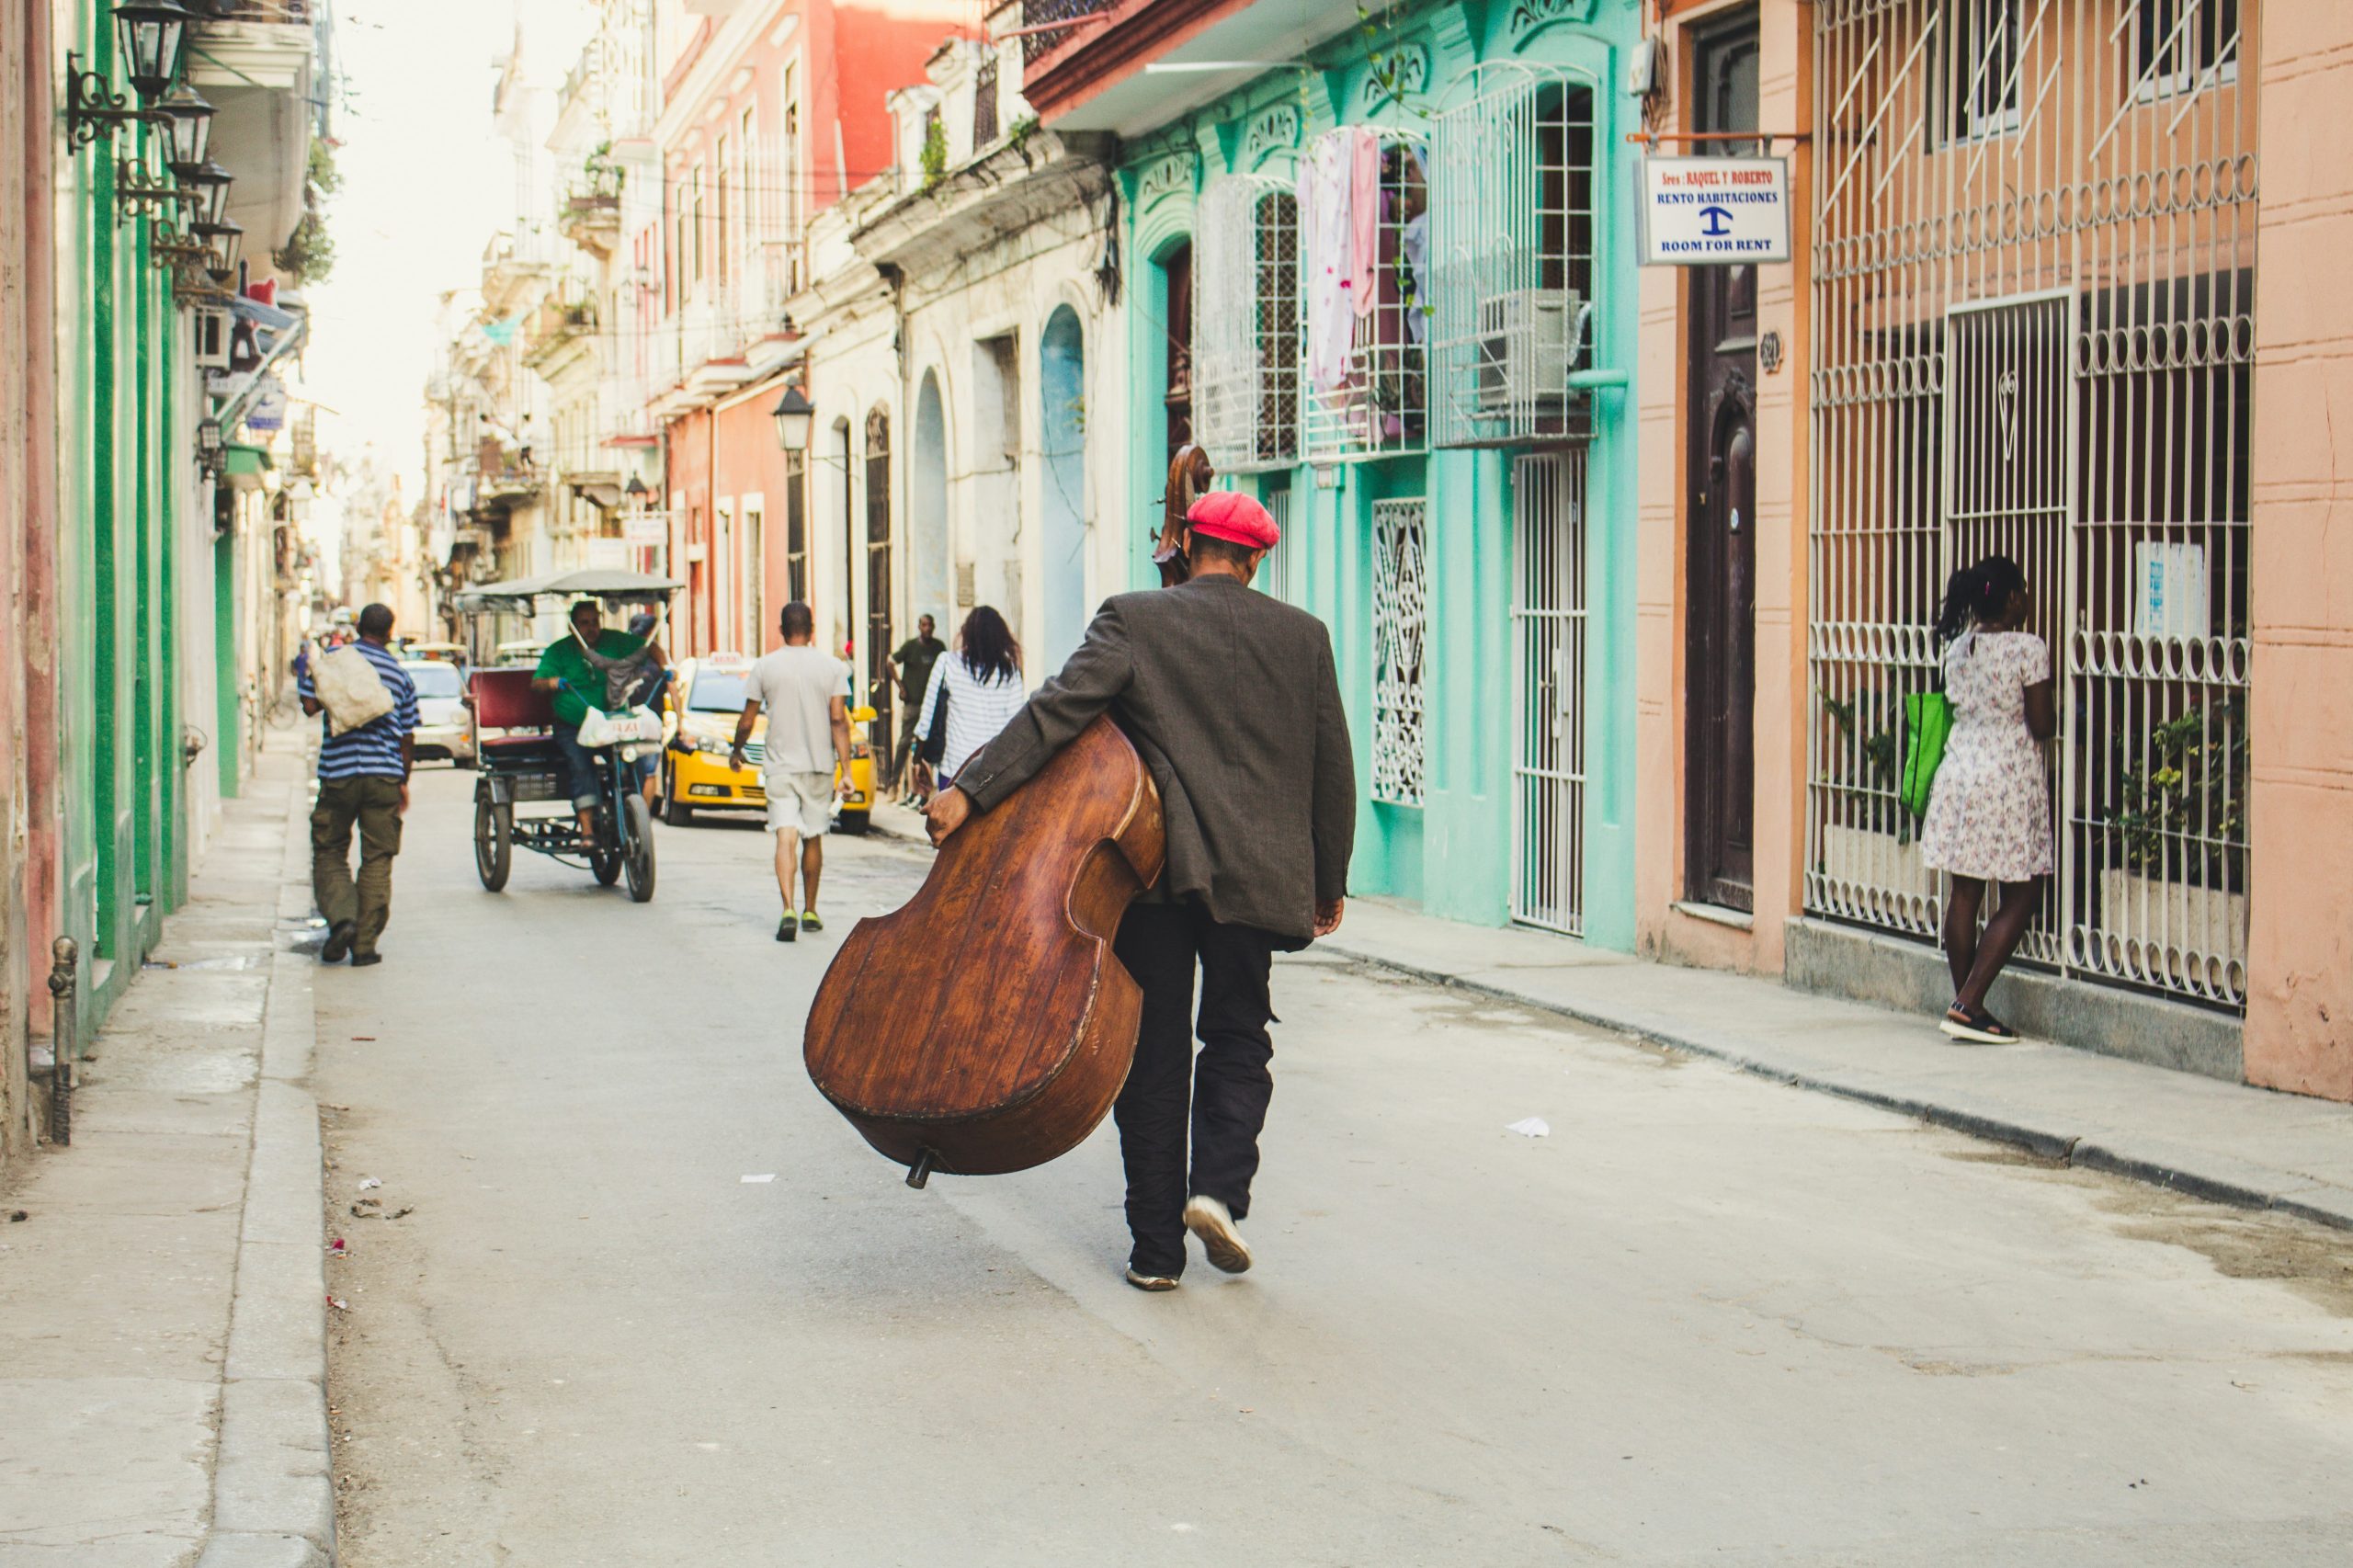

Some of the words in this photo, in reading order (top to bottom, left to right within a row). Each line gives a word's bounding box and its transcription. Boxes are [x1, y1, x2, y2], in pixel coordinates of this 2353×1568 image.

[1687, 170, 1720, 187] RAQUEL
[1722, 171, 1729, 184] Y
[1732, 170, 1773, 184] ROBERTO
[1657, 193, 1694, 204] RENTO
[1698, 191, 1778, 203] HABITACIONES
[1661, 241, 1702, 252] ROOM
[1706, 240, 1733, 251] FOR
[1736, 239, 1771, 251] RENT
